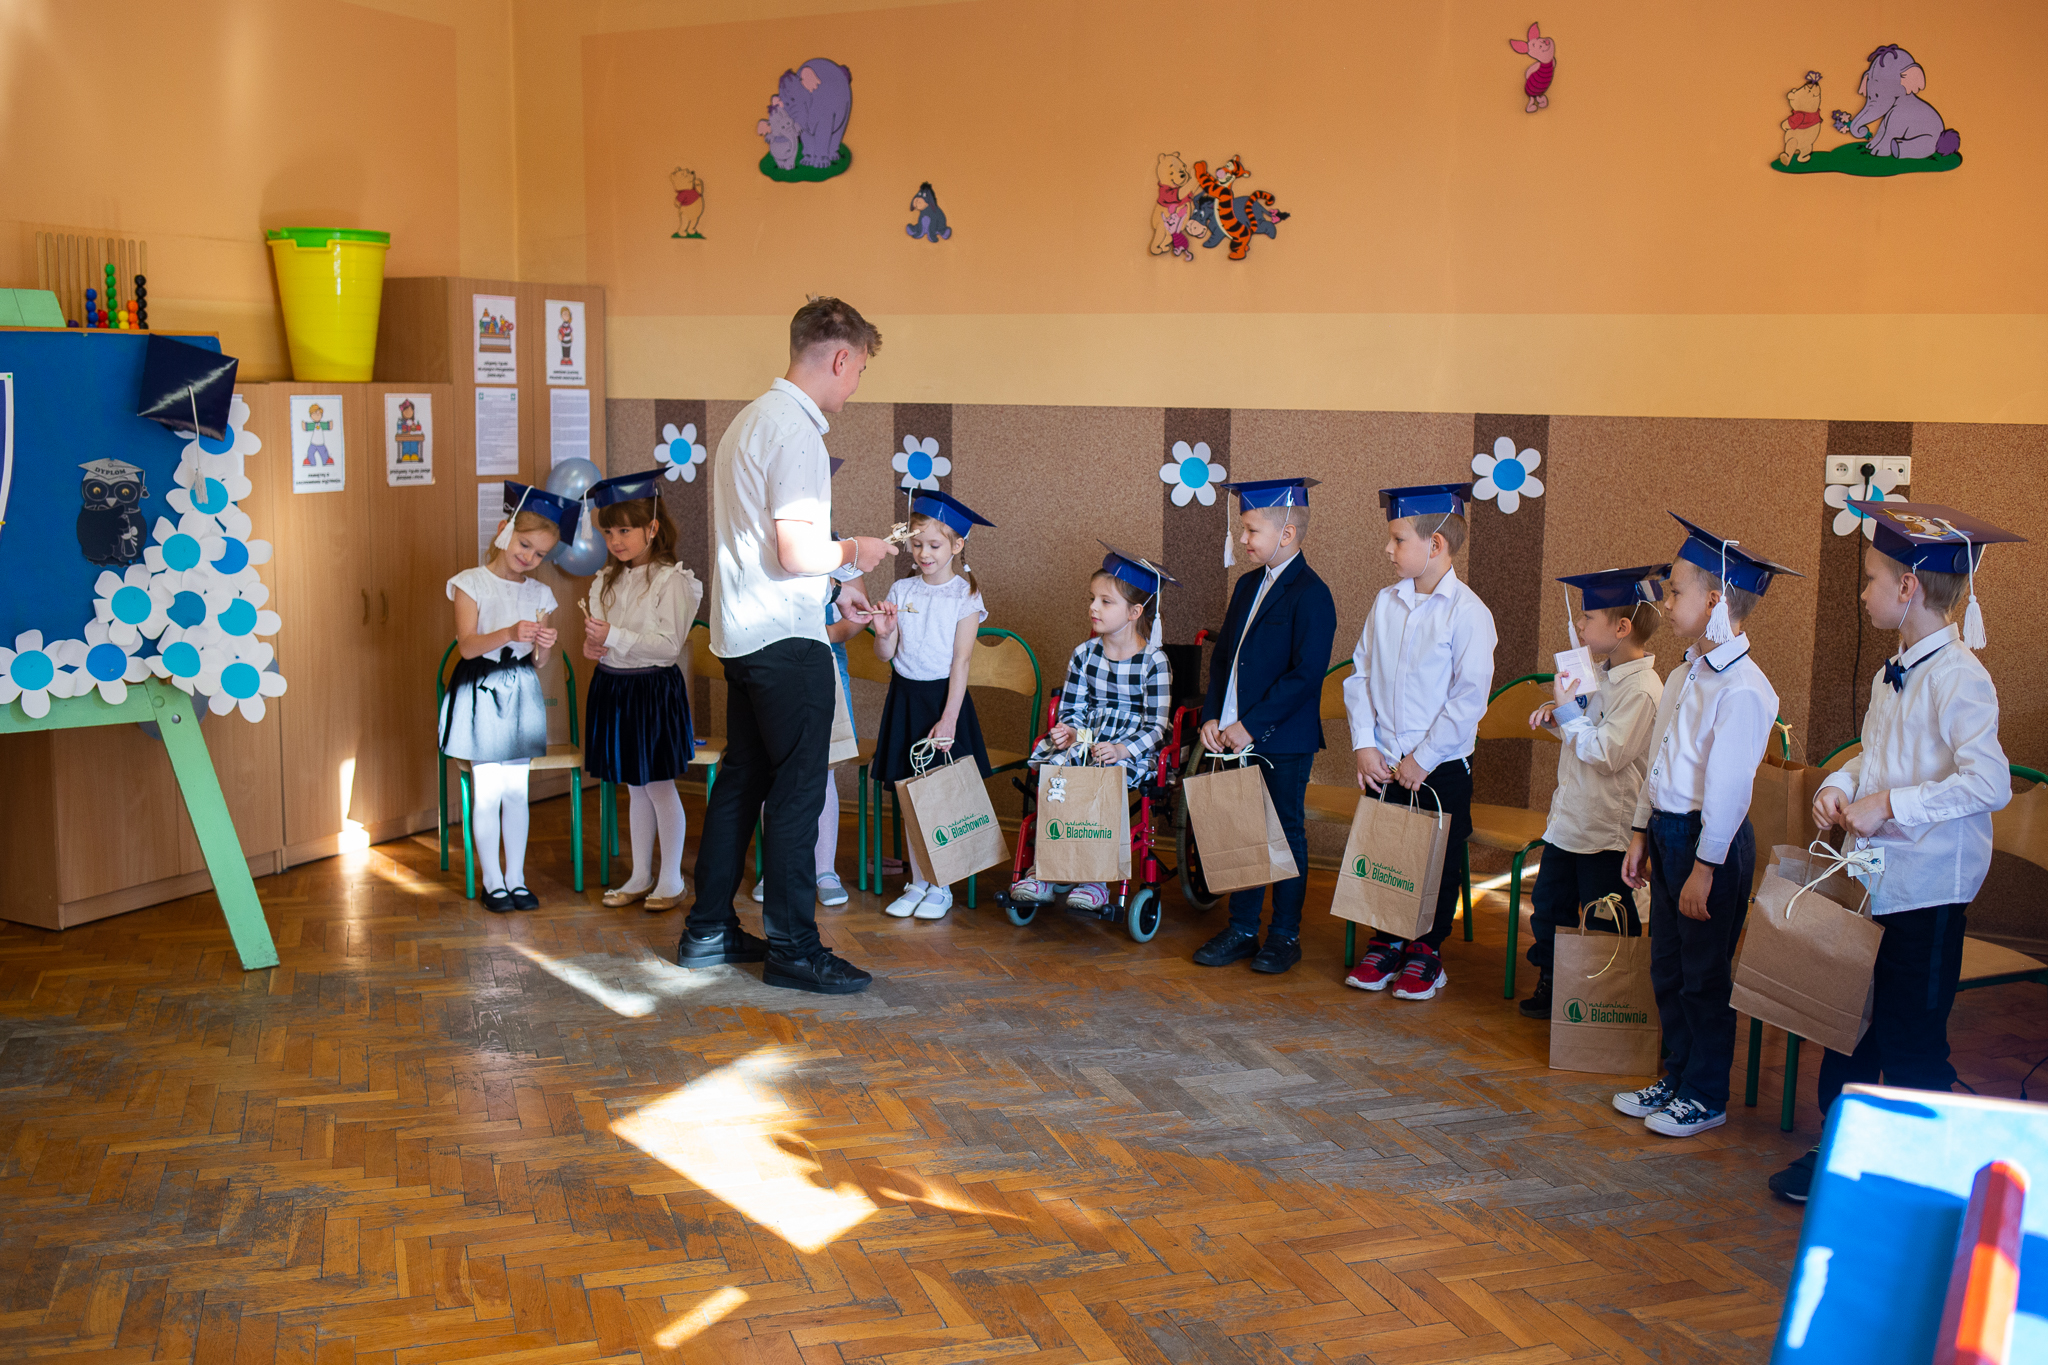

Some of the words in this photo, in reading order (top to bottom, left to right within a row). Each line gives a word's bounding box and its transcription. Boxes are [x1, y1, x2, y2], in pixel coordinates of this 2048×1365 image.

[94, 466, 126, 476] DYPLOM
[950, 814, 990, 839] Blachownia
[1066, 826, 1112, 839] Blachownia
[1371, 867, 1415, 893] Blachownia
[1591, 1008, 1648, 1024] Blachownia
